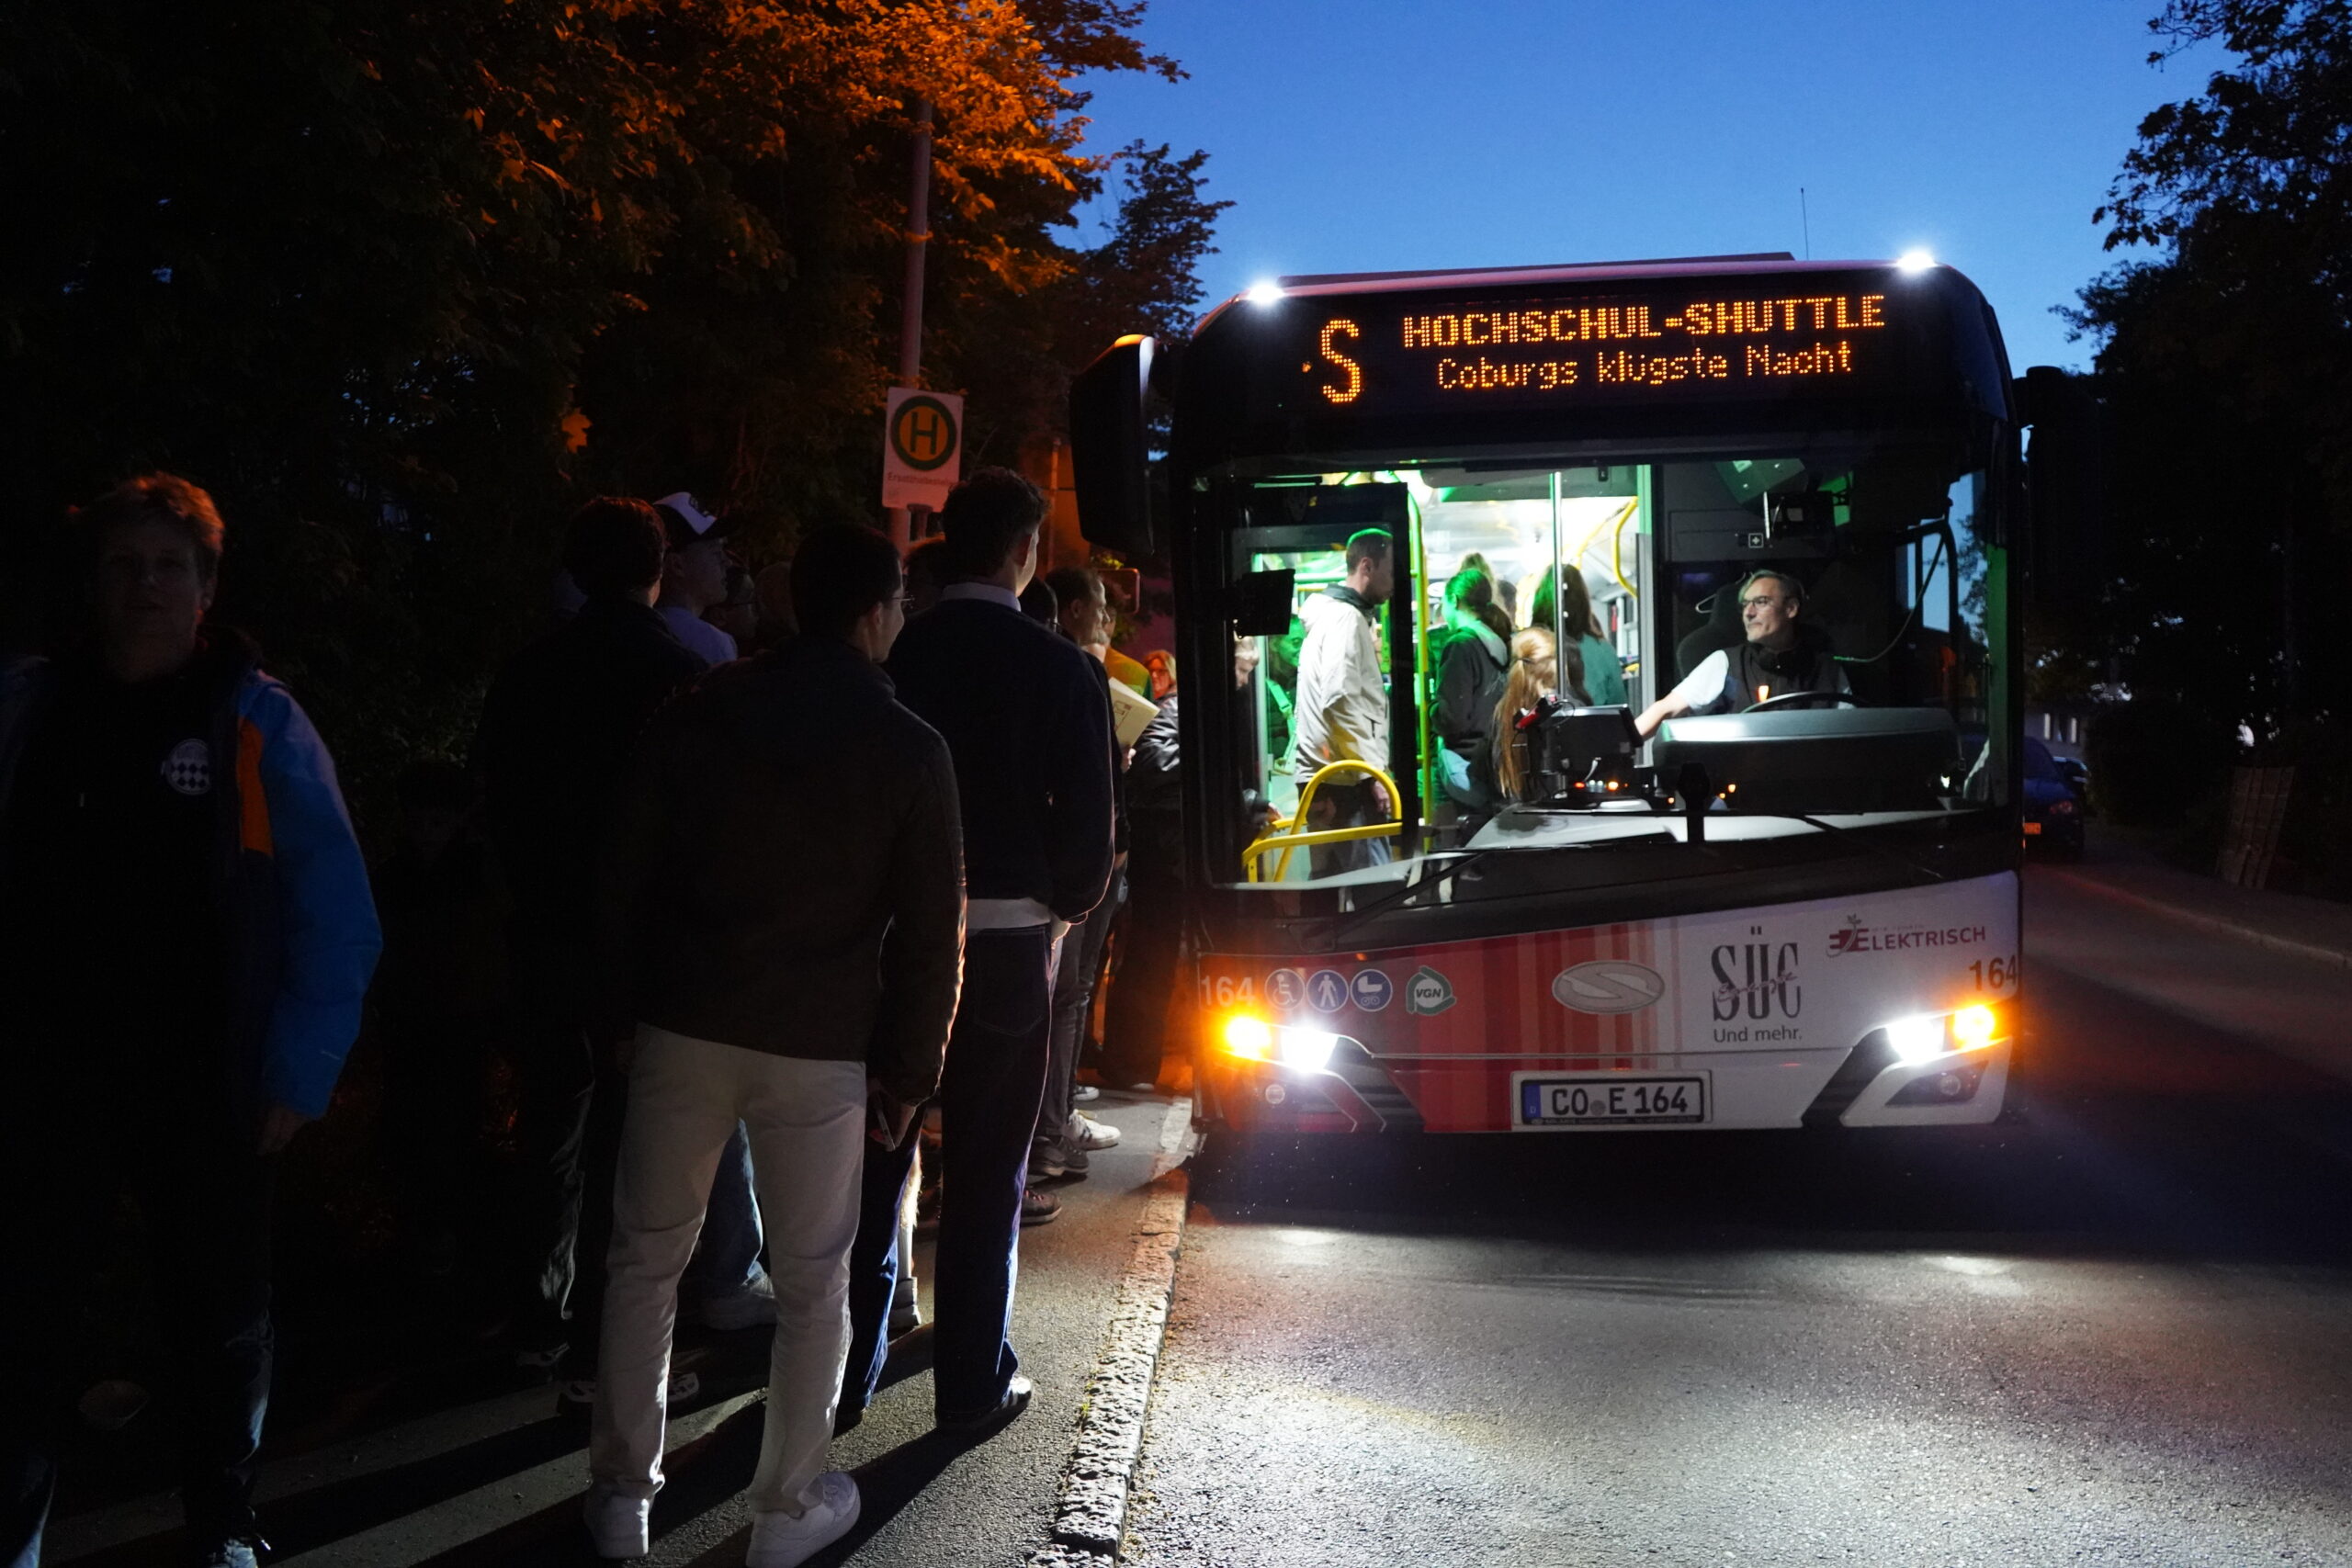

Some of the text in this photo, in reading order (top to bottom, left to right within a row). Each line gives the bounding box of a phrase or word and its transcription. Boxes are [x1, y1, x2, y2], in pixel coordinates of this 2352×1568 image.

[1403, 295, 1885, 348] HOCHSCHUL-SHUTTLE
[1321, 319, 1361, 404] S
[1436, 340, 1852, 389] Coburgs klügste Nacht
[910, 412, 939, 456] H
[1201, 975, 1258, 1009] 164
[1416, 987, 1442, 999] VGN
[1969, 953, 2018, 993] 164
[1713, 1026, 1748, 1043] Und
[1551, 1088, 1589, 1116] CO
